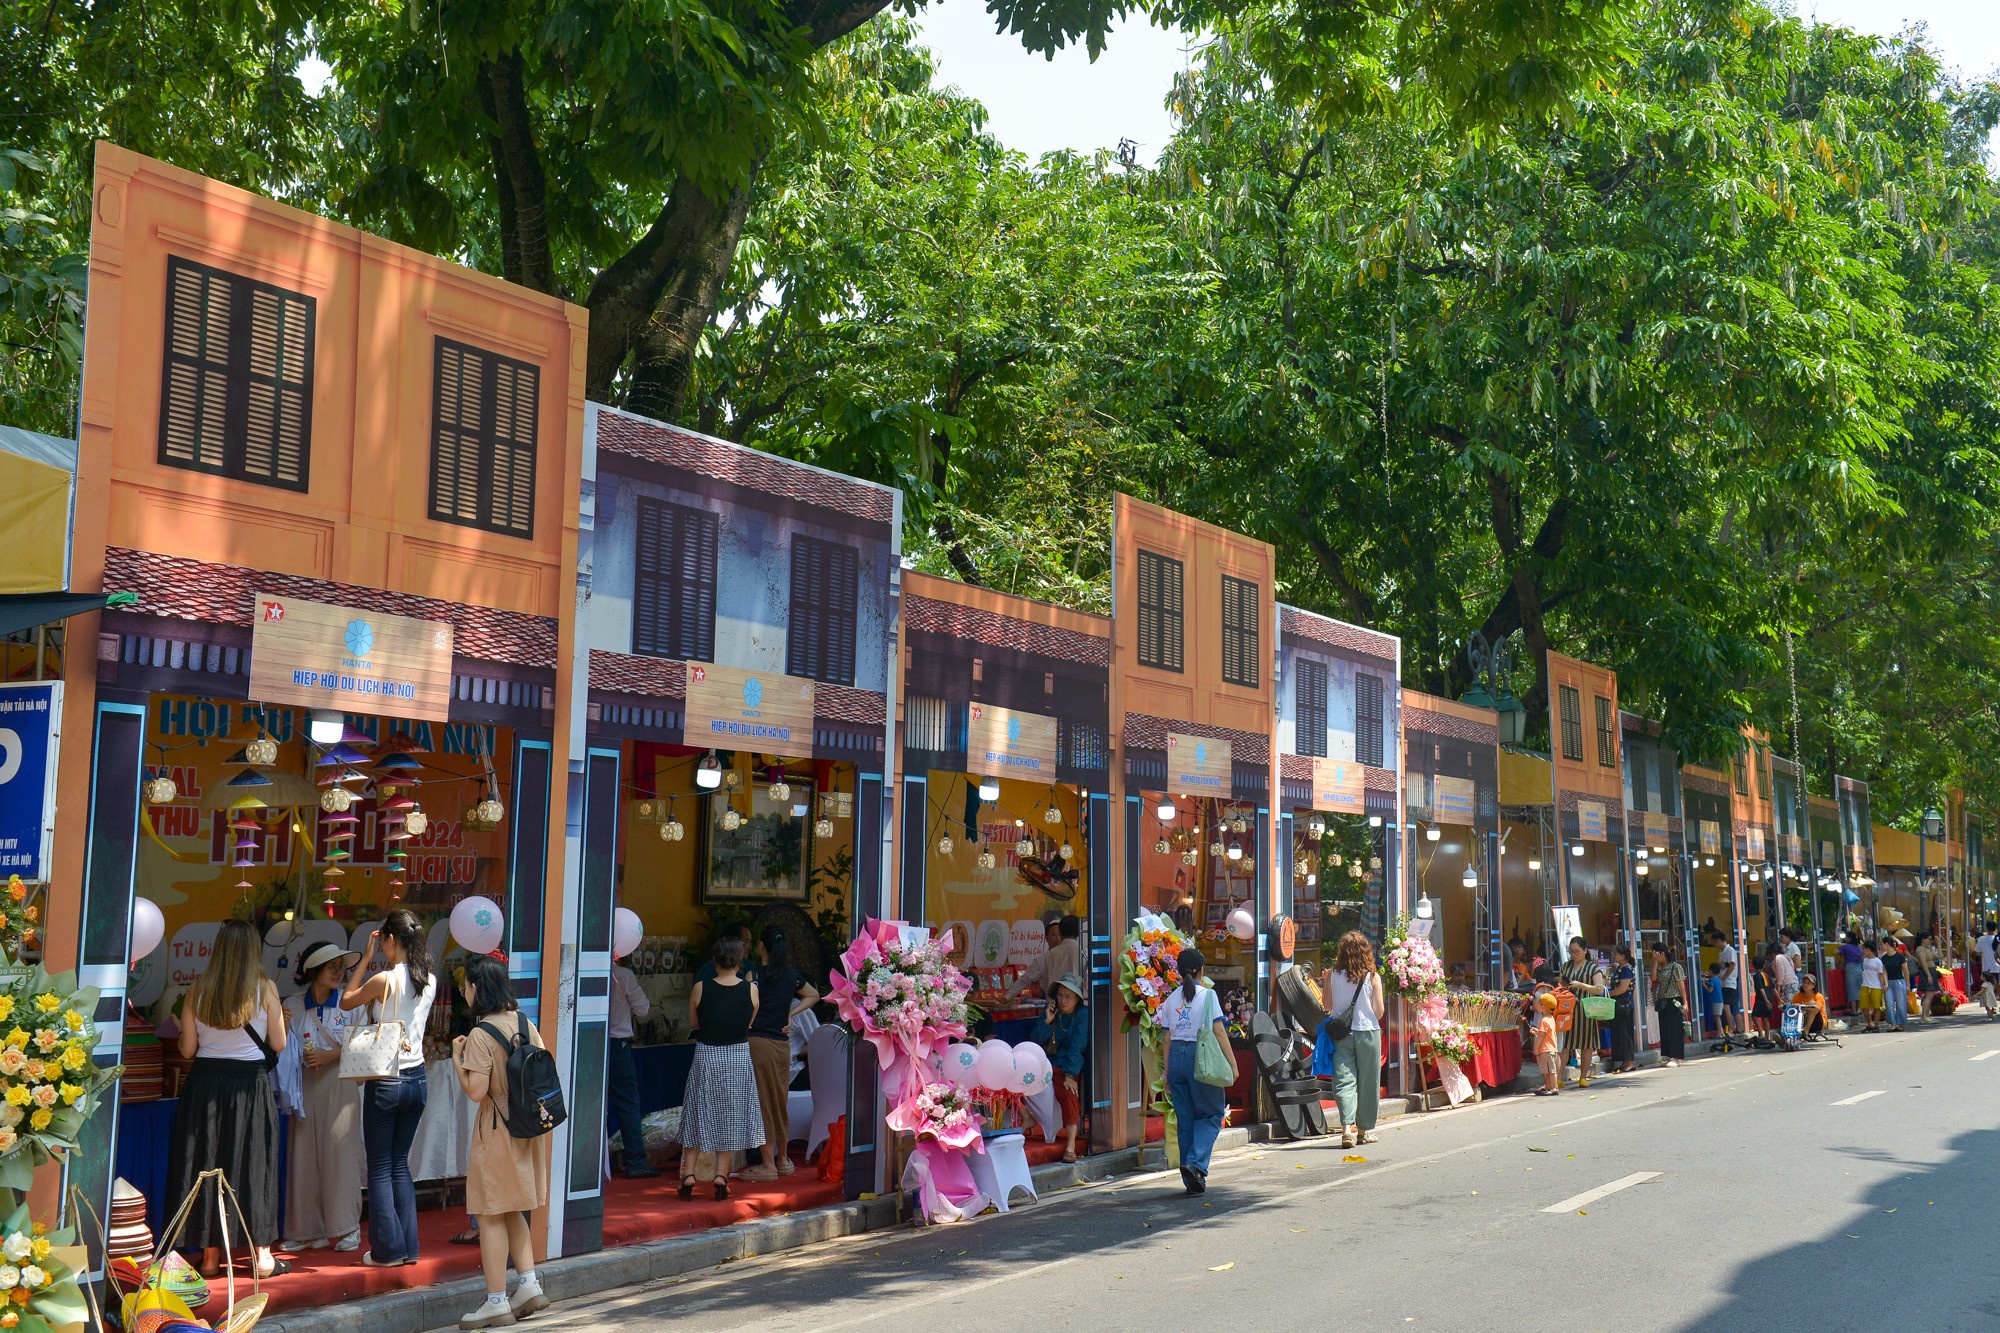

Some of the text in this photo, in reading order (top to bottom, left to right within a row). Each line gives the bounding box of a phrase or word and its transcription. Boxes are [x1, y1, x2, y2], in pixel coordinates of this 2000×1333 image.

[342, 658, 372, 670] HANTA
[293, 668, 415, 701] HIỆP HỘI DU LỊCH HÀ NỘI
[0, 697, 48, 714] VẬN TẢI HÀ NỘI
[160, 696, 232, 746] HỘI
[711, 718, 790, 742] HIỆP HỘI DU LỊCH HÀ NỘI
[981, 822, 1024, 844] FESTIVA
[5, 838, 18, 849] MTV
[2, 852, 32, 868] XE HÀ NỘI
[404, 854, 447, 891] LỊCH
[172, 940, 212, 958] Từ bi
